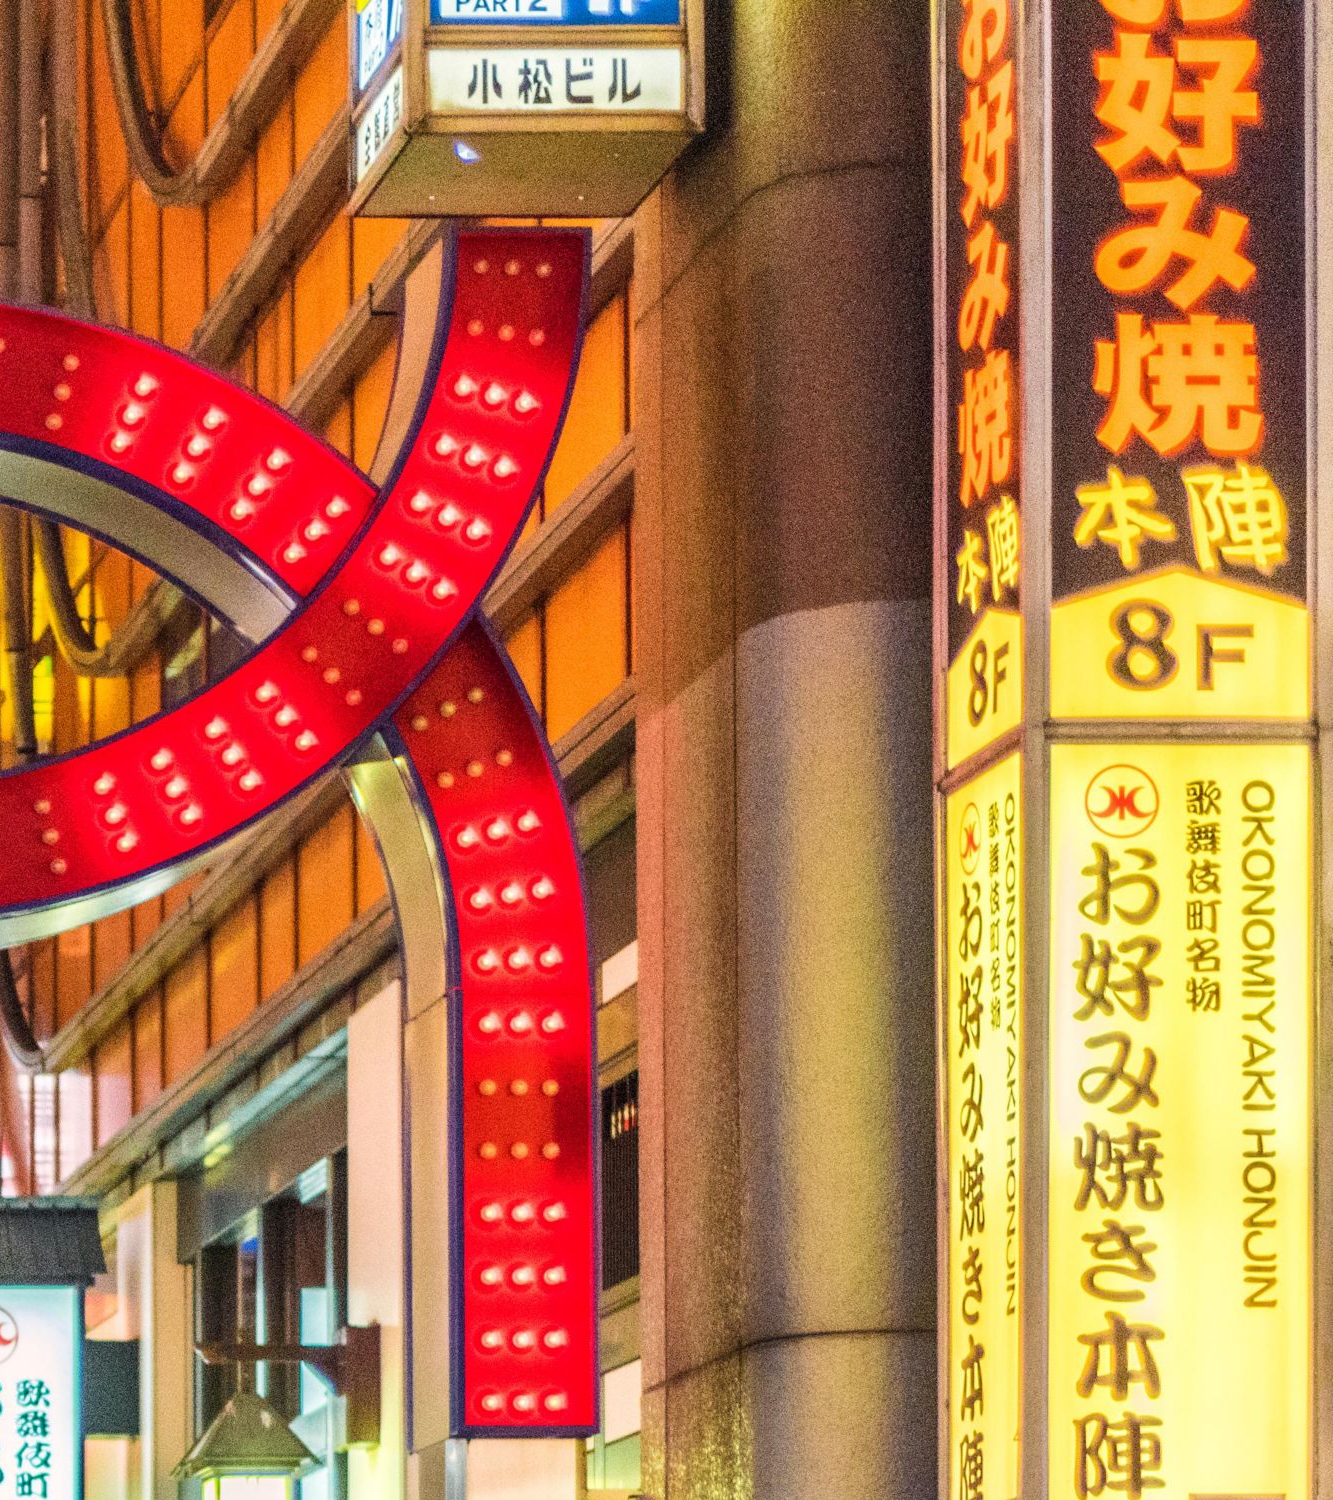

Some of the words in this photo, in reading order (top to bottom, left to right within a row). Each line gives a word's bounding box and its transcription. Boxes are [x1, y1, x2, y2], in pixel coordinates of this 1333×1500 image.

[467, 57, 643, 105] 小松ビル
[1093, 0, 1263, 457] 好み焼
[957, 497, 1019, 615] 本陣
[1075, 462, 1288, 574] 本陣
[968, 636, 1010, 729] 8F
[1106, 600, 1255, 692] 8F
[1184, 780, 1222, 1013] 歌舞伎町名物
[1240, 779, 1277, 1112] OKONOMIYAKI
[1242, 1129, 1278, 1309] HONJIN
